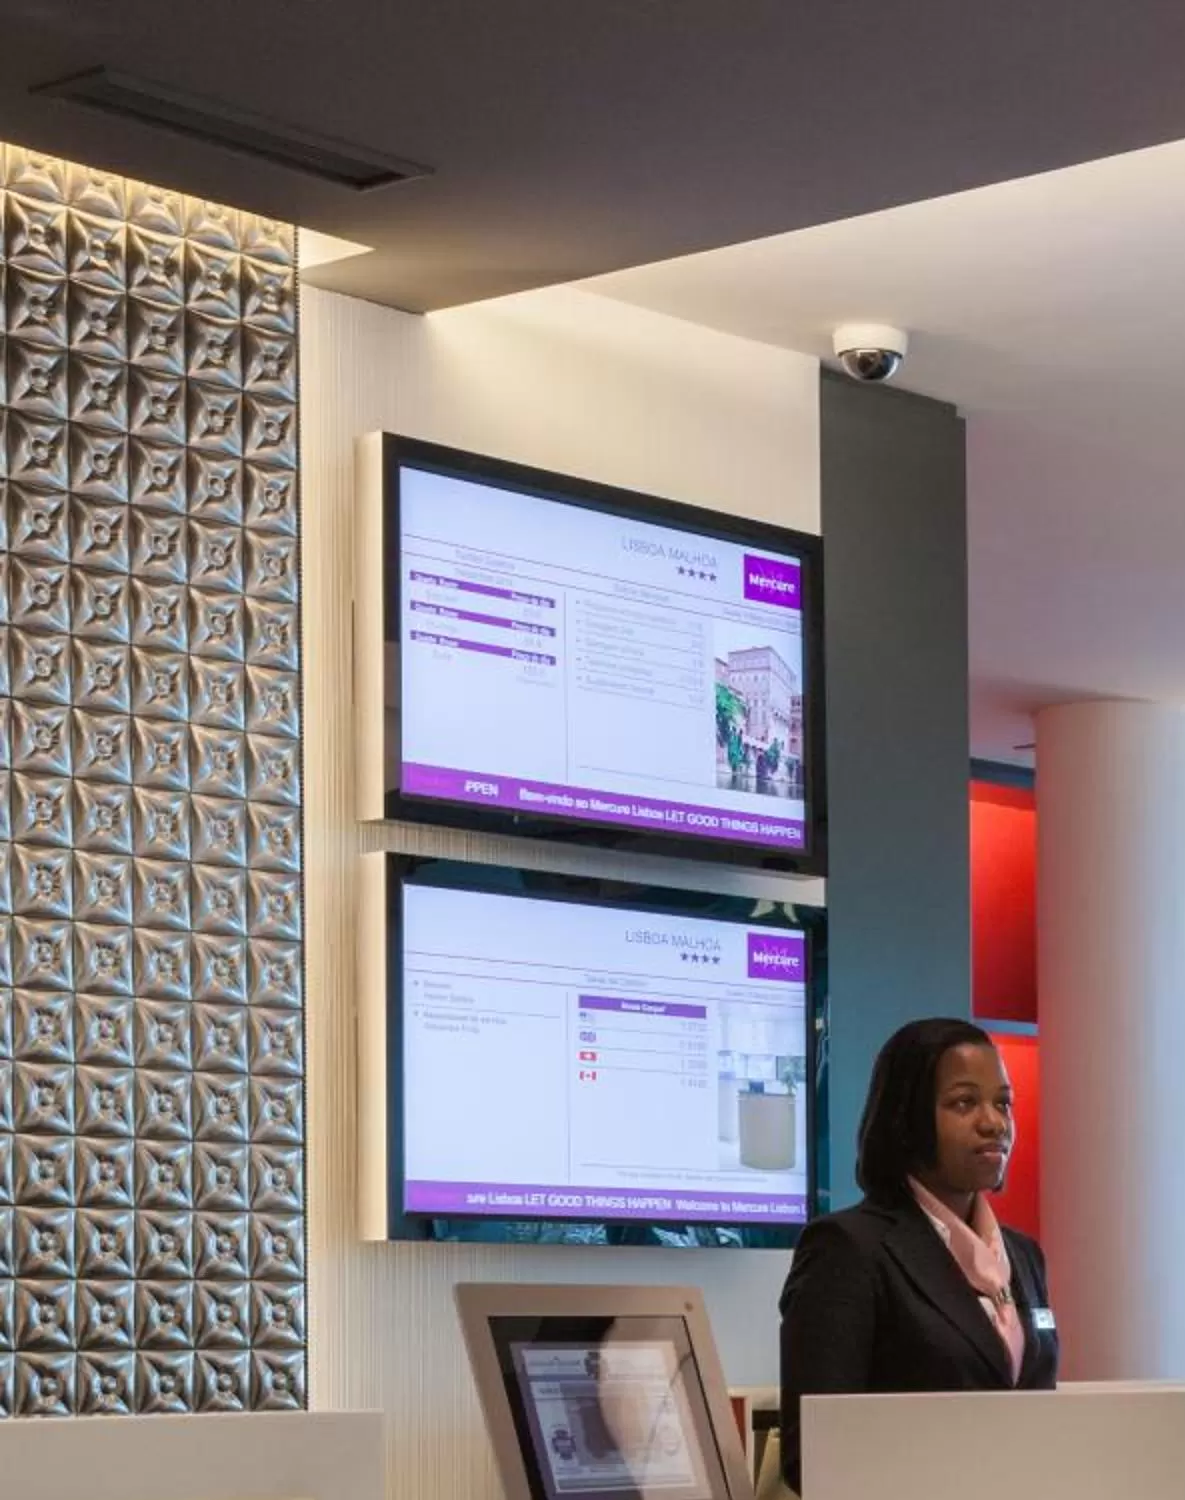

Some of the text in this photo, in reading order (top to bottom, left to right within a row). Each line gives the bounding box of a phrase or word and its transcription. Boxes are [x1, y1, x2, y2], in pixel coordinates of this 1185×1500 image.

[749, 573, 796, 594] Mercure
[665, 809, 685, 823] LET
[687, 813, 719, 828] GOOD
[625, 929, 721, 952] LISBOA MALHOA
[753, 951, 800, 968] Mercure
[525, 1194, 547, 1206] LET
[548, 1195, 583, 1207] GOOD
